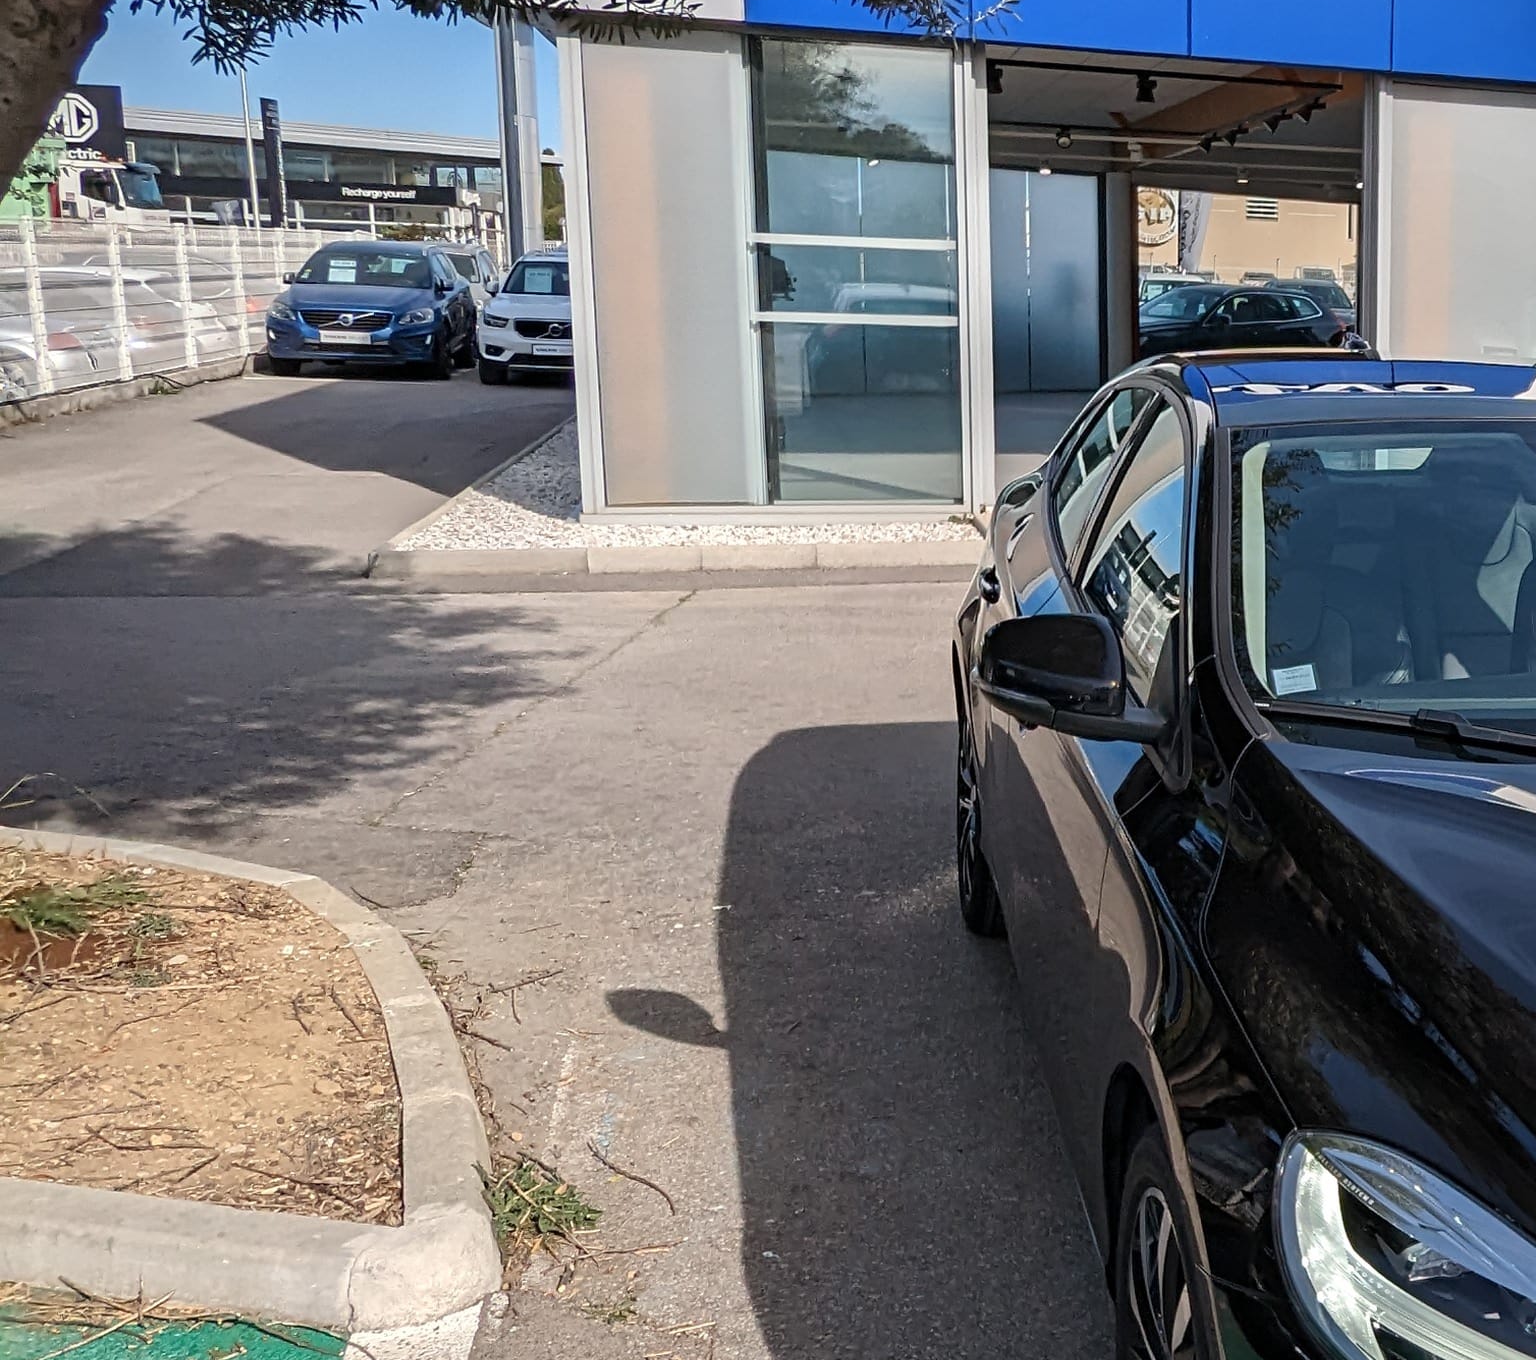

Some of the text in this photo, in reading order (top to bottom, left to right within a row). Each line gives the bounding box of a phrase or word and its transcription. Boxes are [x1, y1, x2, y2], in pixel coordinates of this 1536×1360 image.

[48, 94, 97, 140] MG
[68, 148, 101, 159] ctric
[342, 187, 416, 199] Recharge yourself
